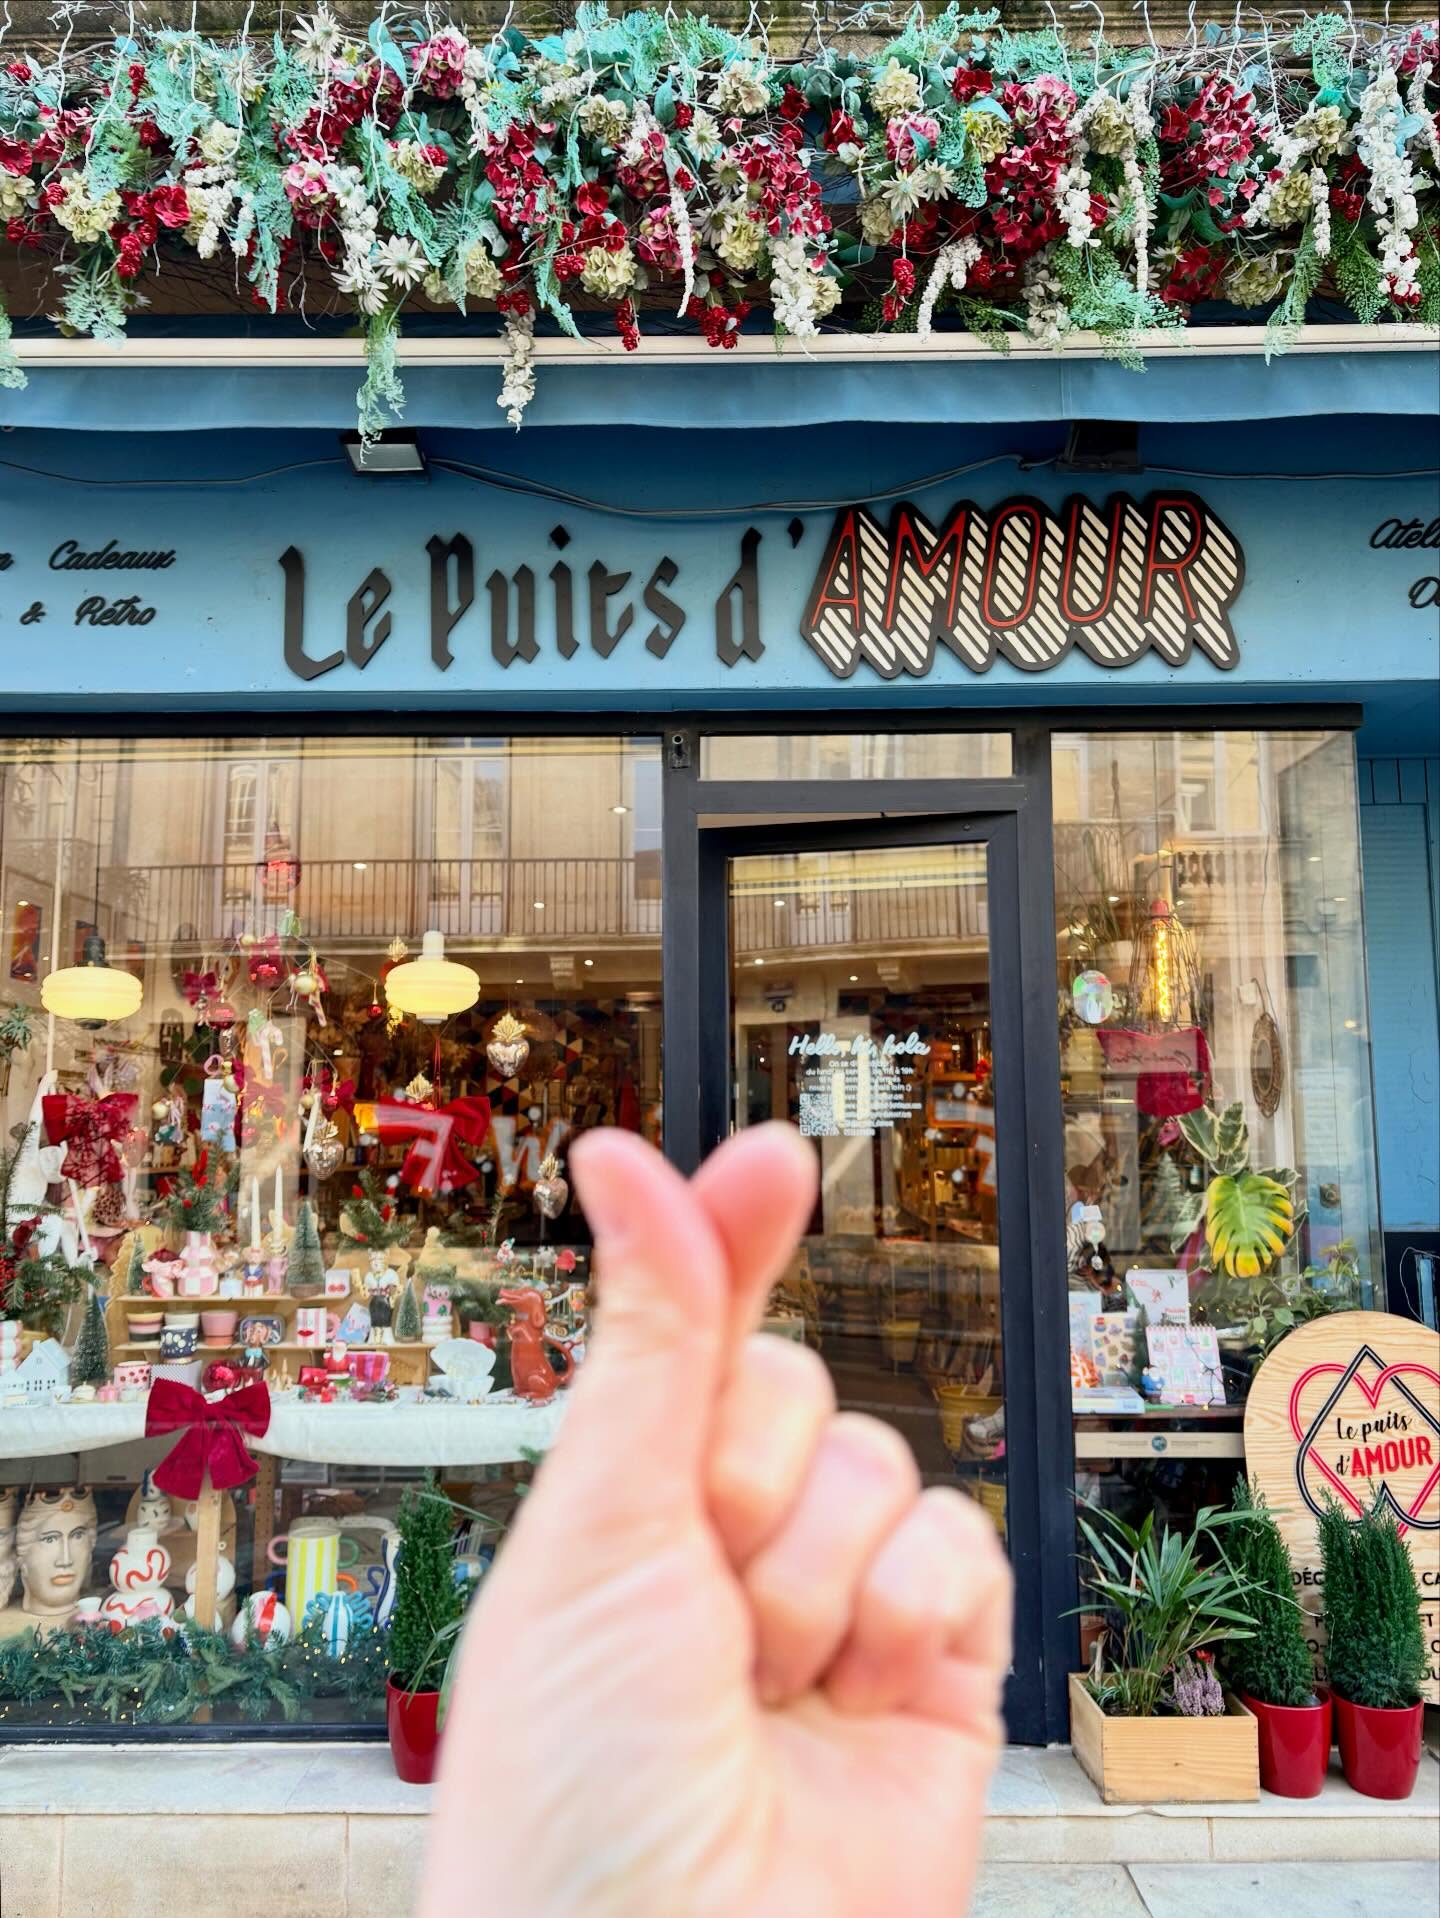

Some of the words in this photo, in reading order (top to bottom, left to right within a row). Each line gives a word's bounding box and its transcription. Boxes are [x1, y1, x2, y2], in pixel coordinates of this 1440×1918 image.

[48, 539, 177, 571] Cadeaux
[20, 601, 47, 627] &
[277, 544, 393, 682] Le
[425, 525, 686, 672] Puits
[1362, 1410, 1413, 1442] puits
